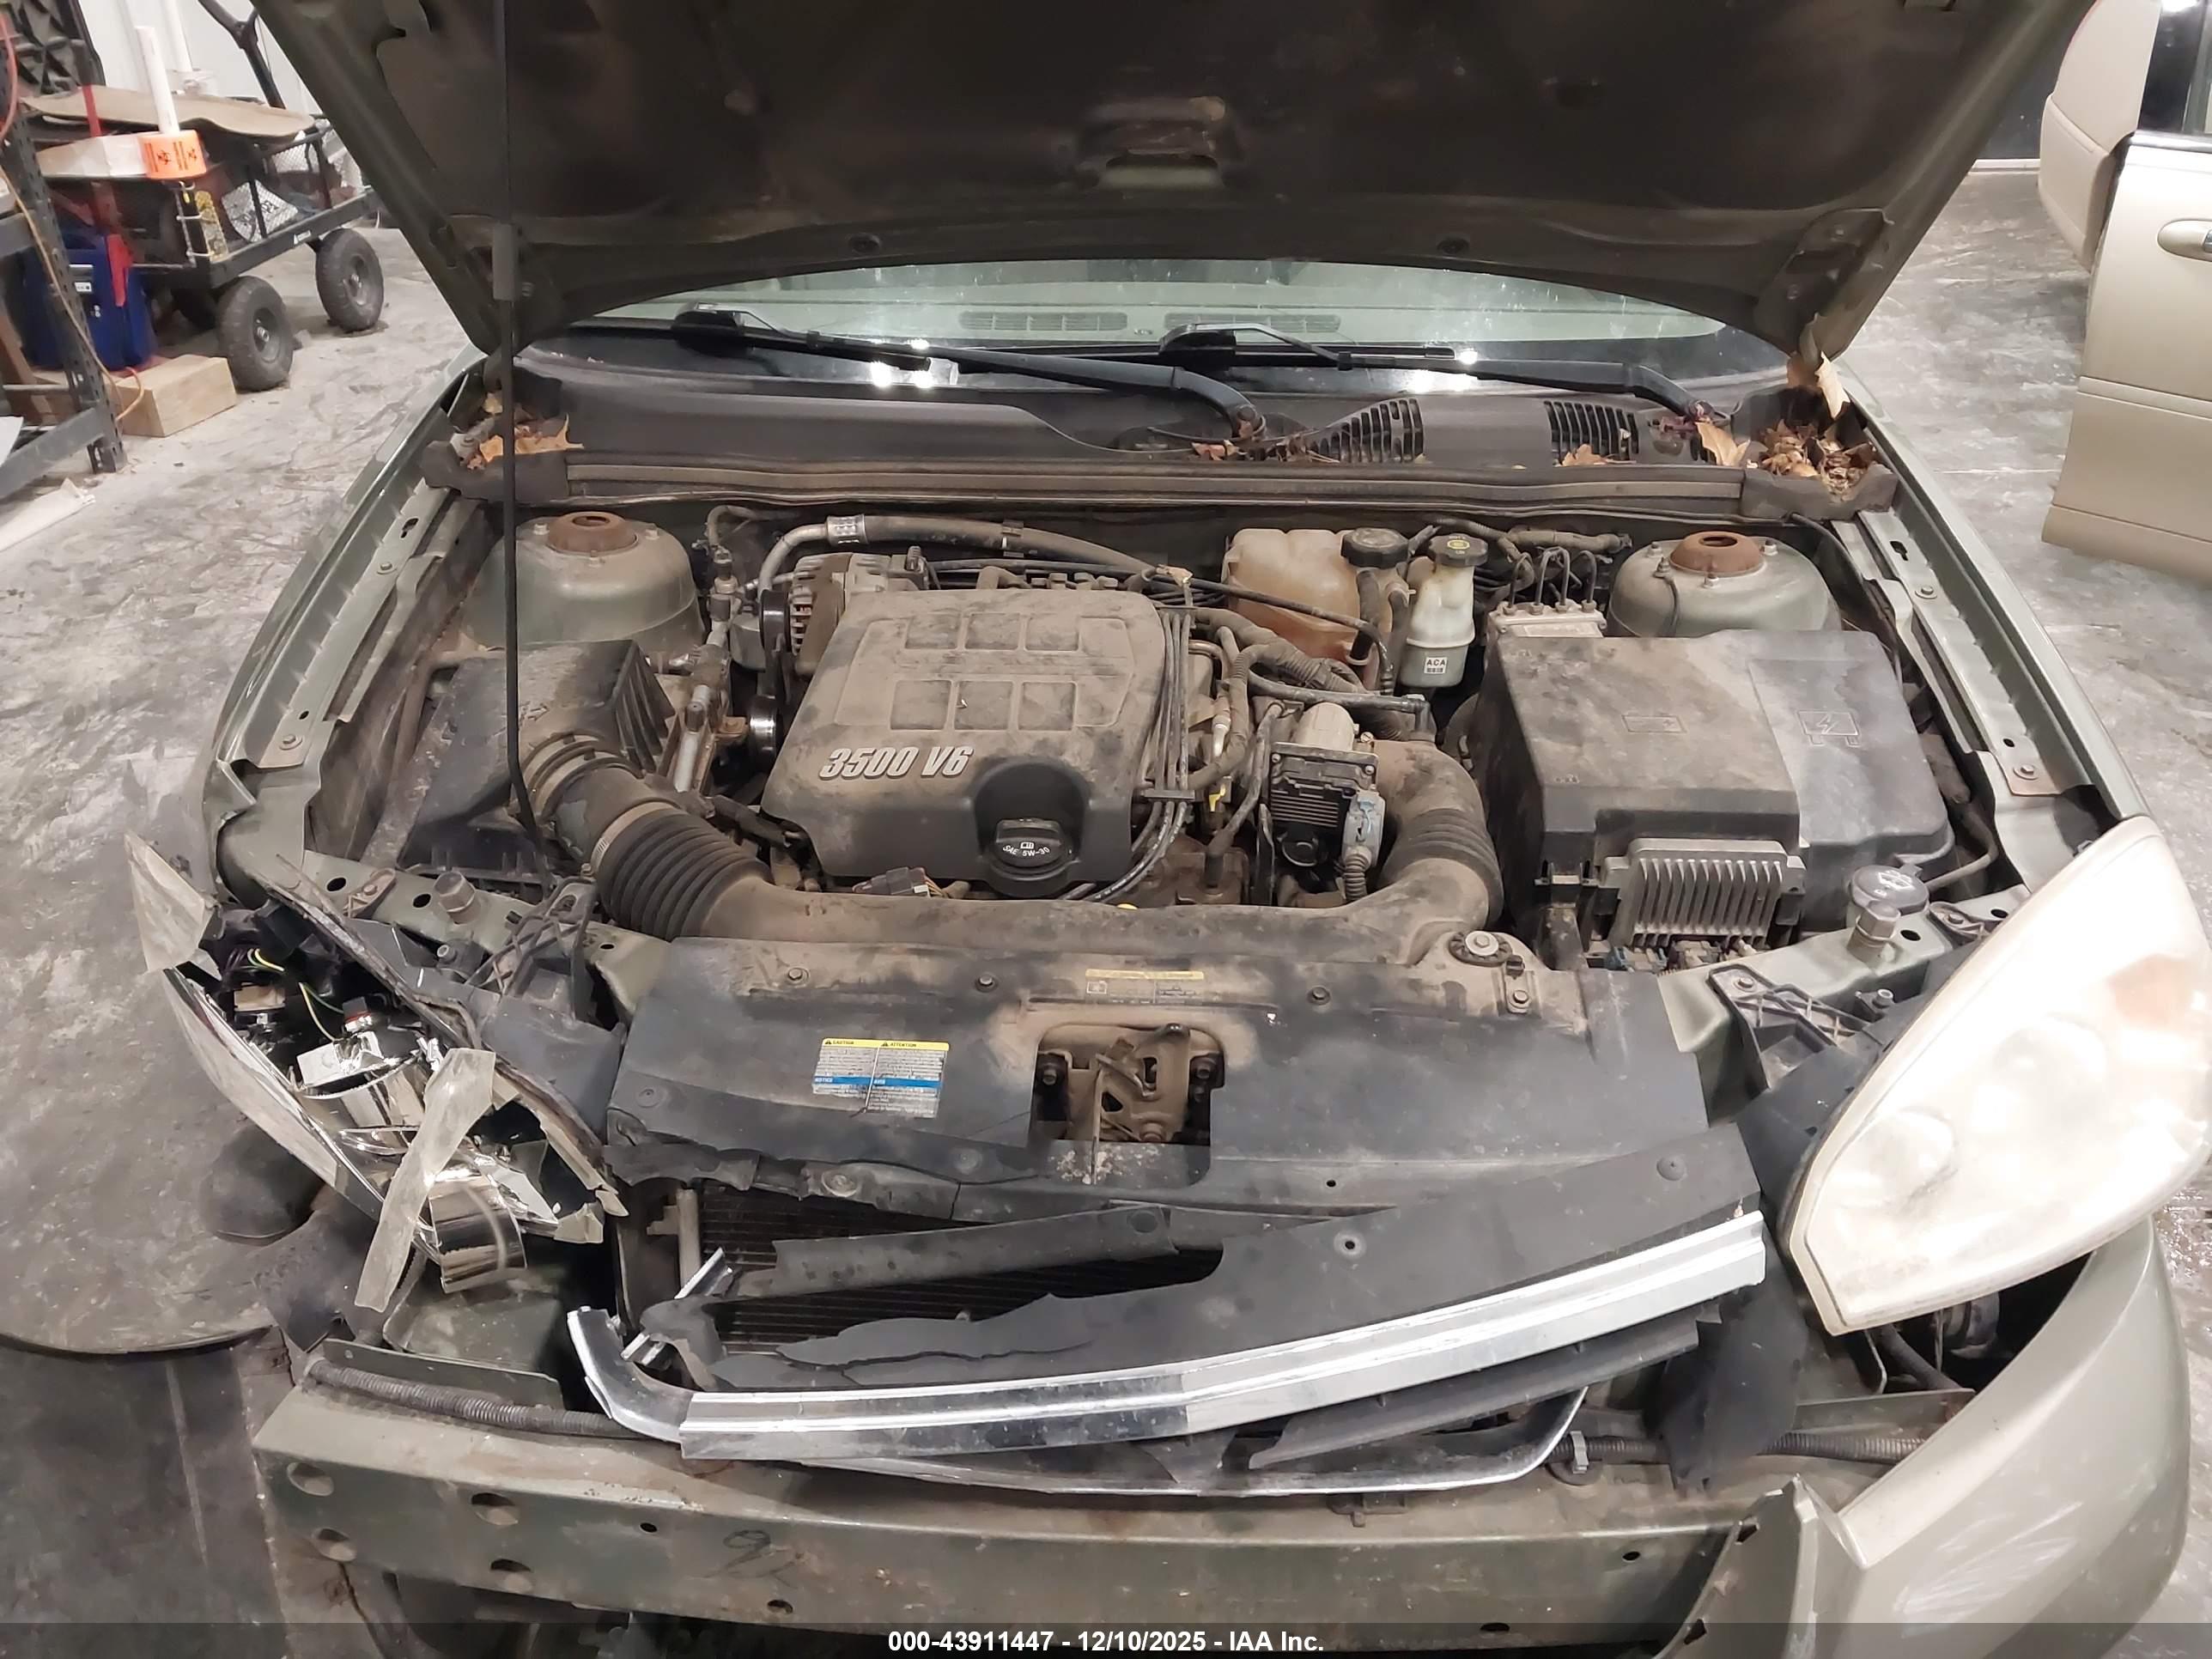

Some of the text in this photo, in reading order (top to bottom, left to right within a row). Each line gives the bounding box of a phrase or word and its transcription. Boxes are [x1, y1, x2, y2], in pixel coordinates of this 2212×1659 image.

[818, 745, 974, 781] 3500 V6
[1003, 845, 1050, 857] SAE 5W-30
